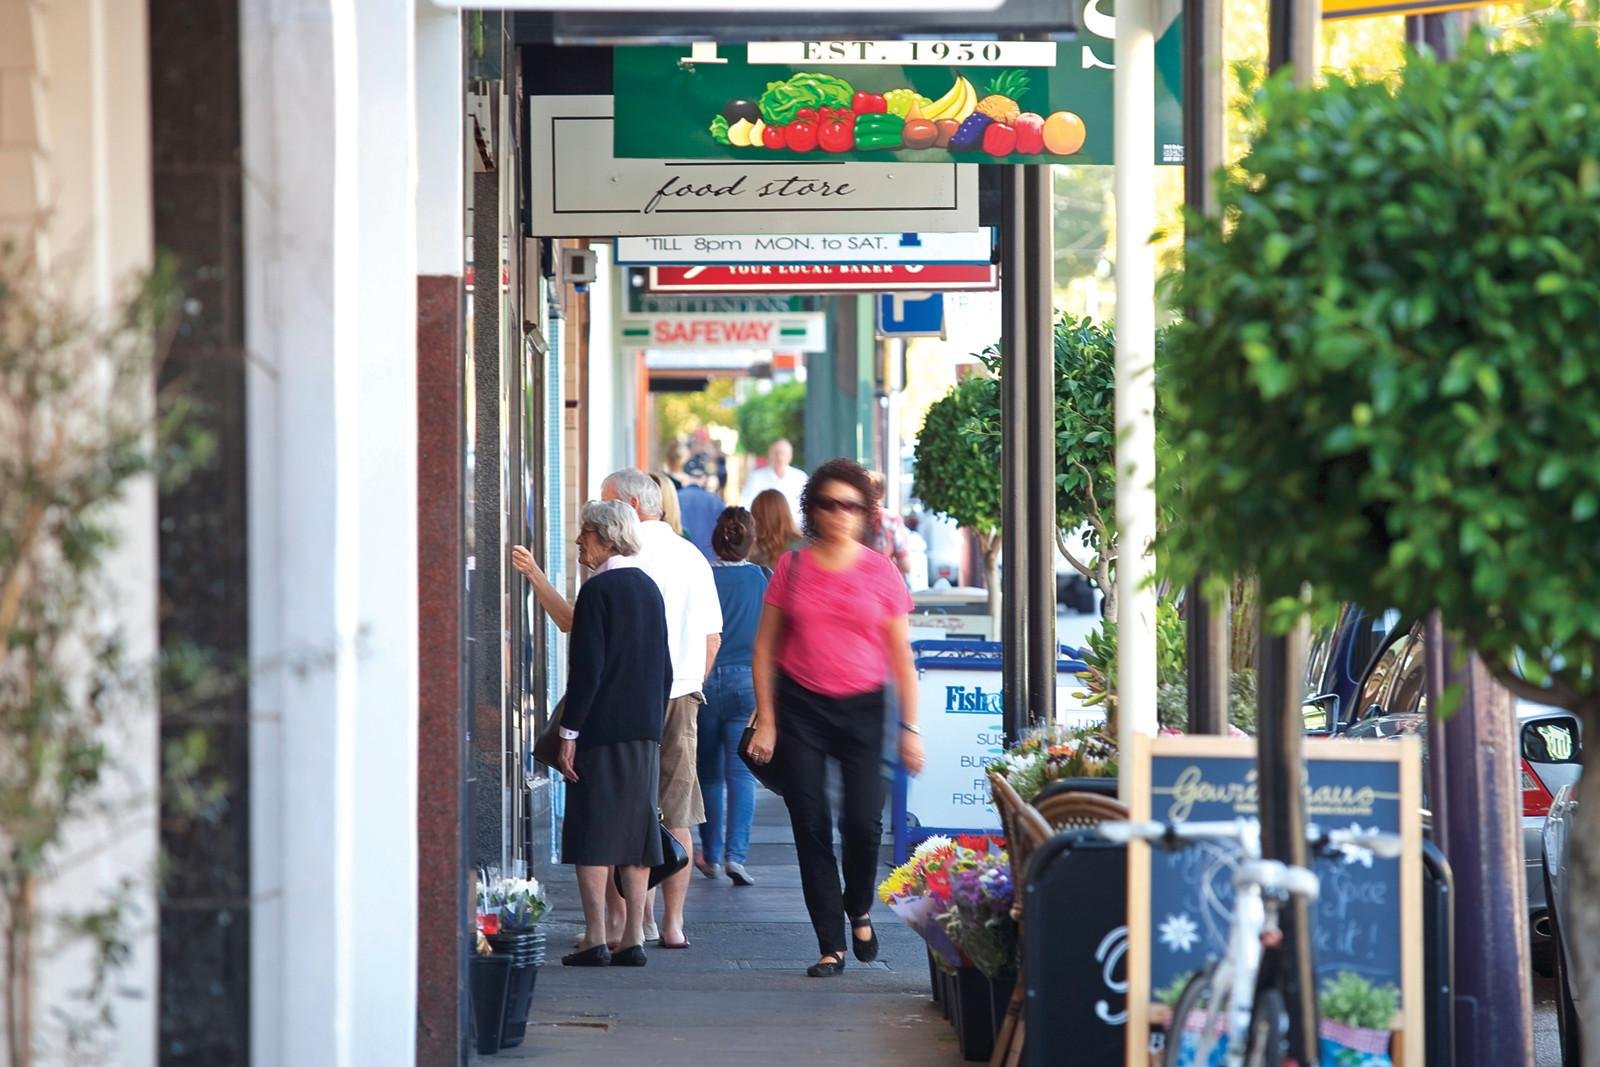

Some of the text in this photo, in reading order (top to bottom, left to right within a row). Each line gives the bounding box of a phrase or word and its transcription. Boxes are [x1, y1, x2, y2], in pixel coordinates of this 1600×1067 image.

[802, 41, 1003, 62] EST. 1950
[643, 175, 856, 214] food store
[694, 237, 742, 253] 8pm
[754, 237, 815, 250] MON.
[822, 237, 842, 250] to
[847, 236, 888, 250] SAT.
[654, 320, 773, 344] SAFEWAY
